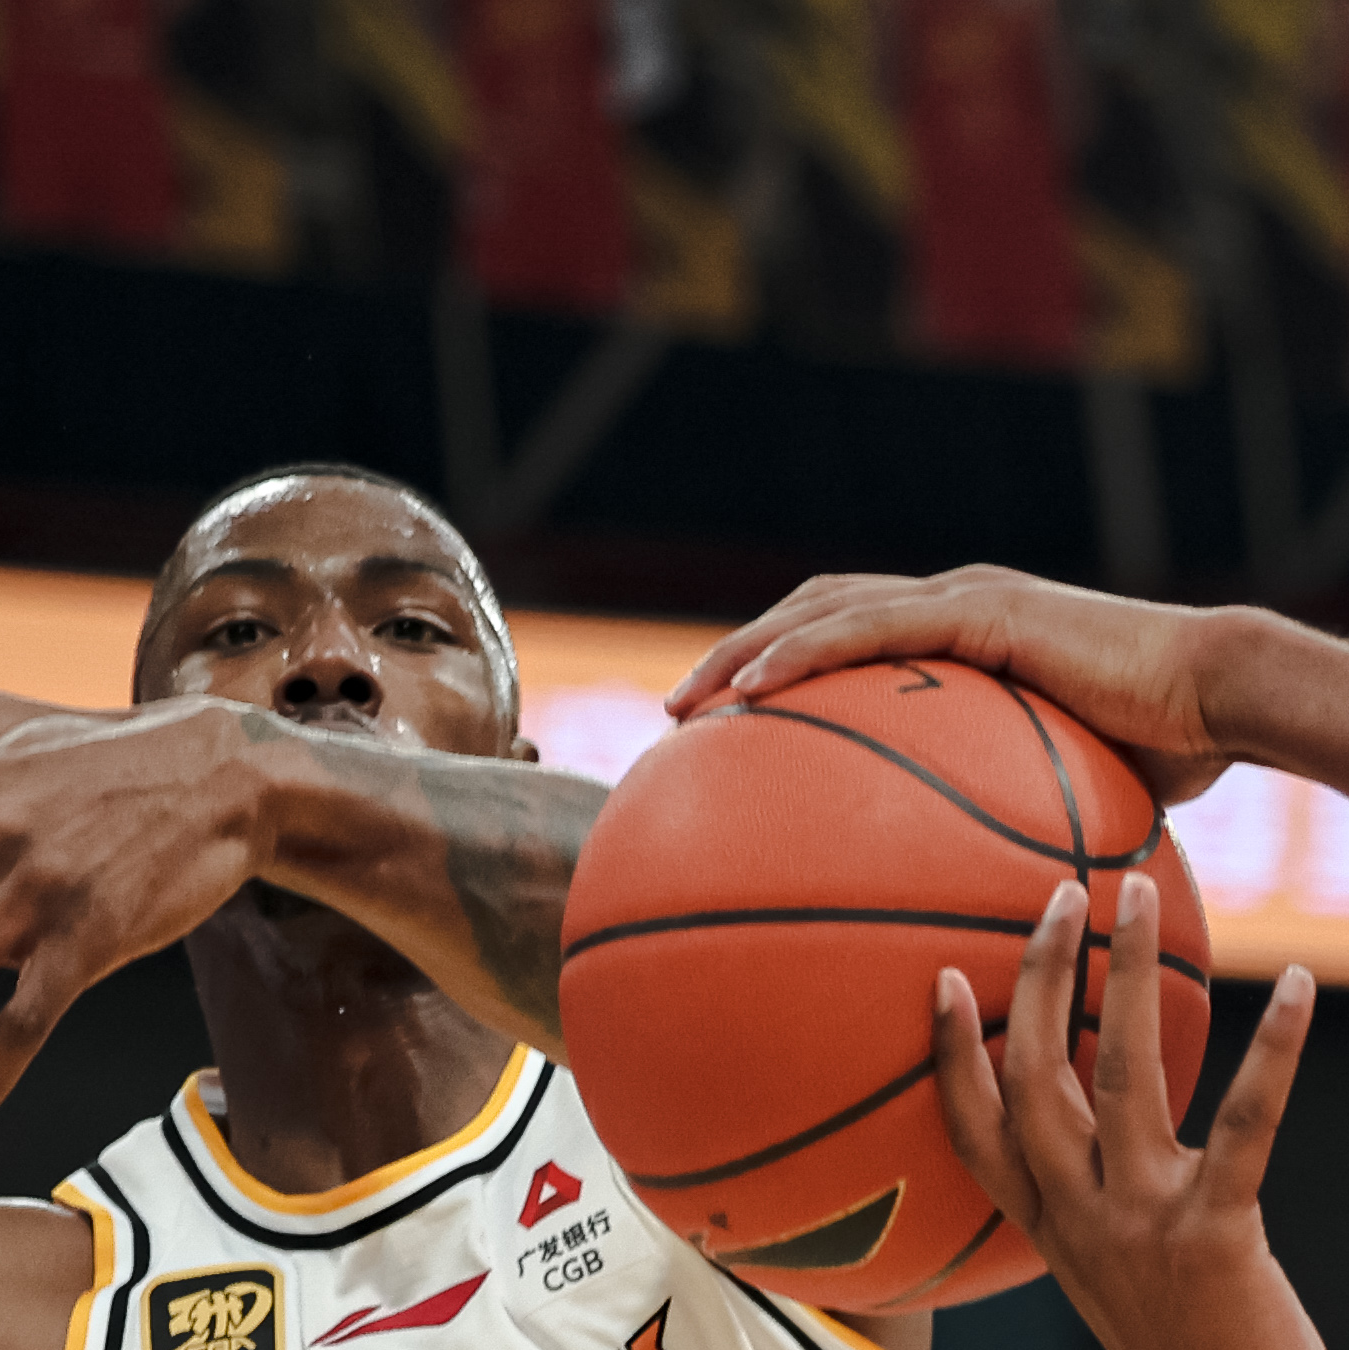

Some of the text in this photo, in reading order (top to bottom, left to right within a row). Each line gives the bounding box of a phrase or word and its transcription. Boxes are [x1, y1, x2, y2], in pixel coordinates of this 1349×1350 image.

[517, 1209, 611, 1279] 广发银行
[543, 1248, 604, 1292] CGB
